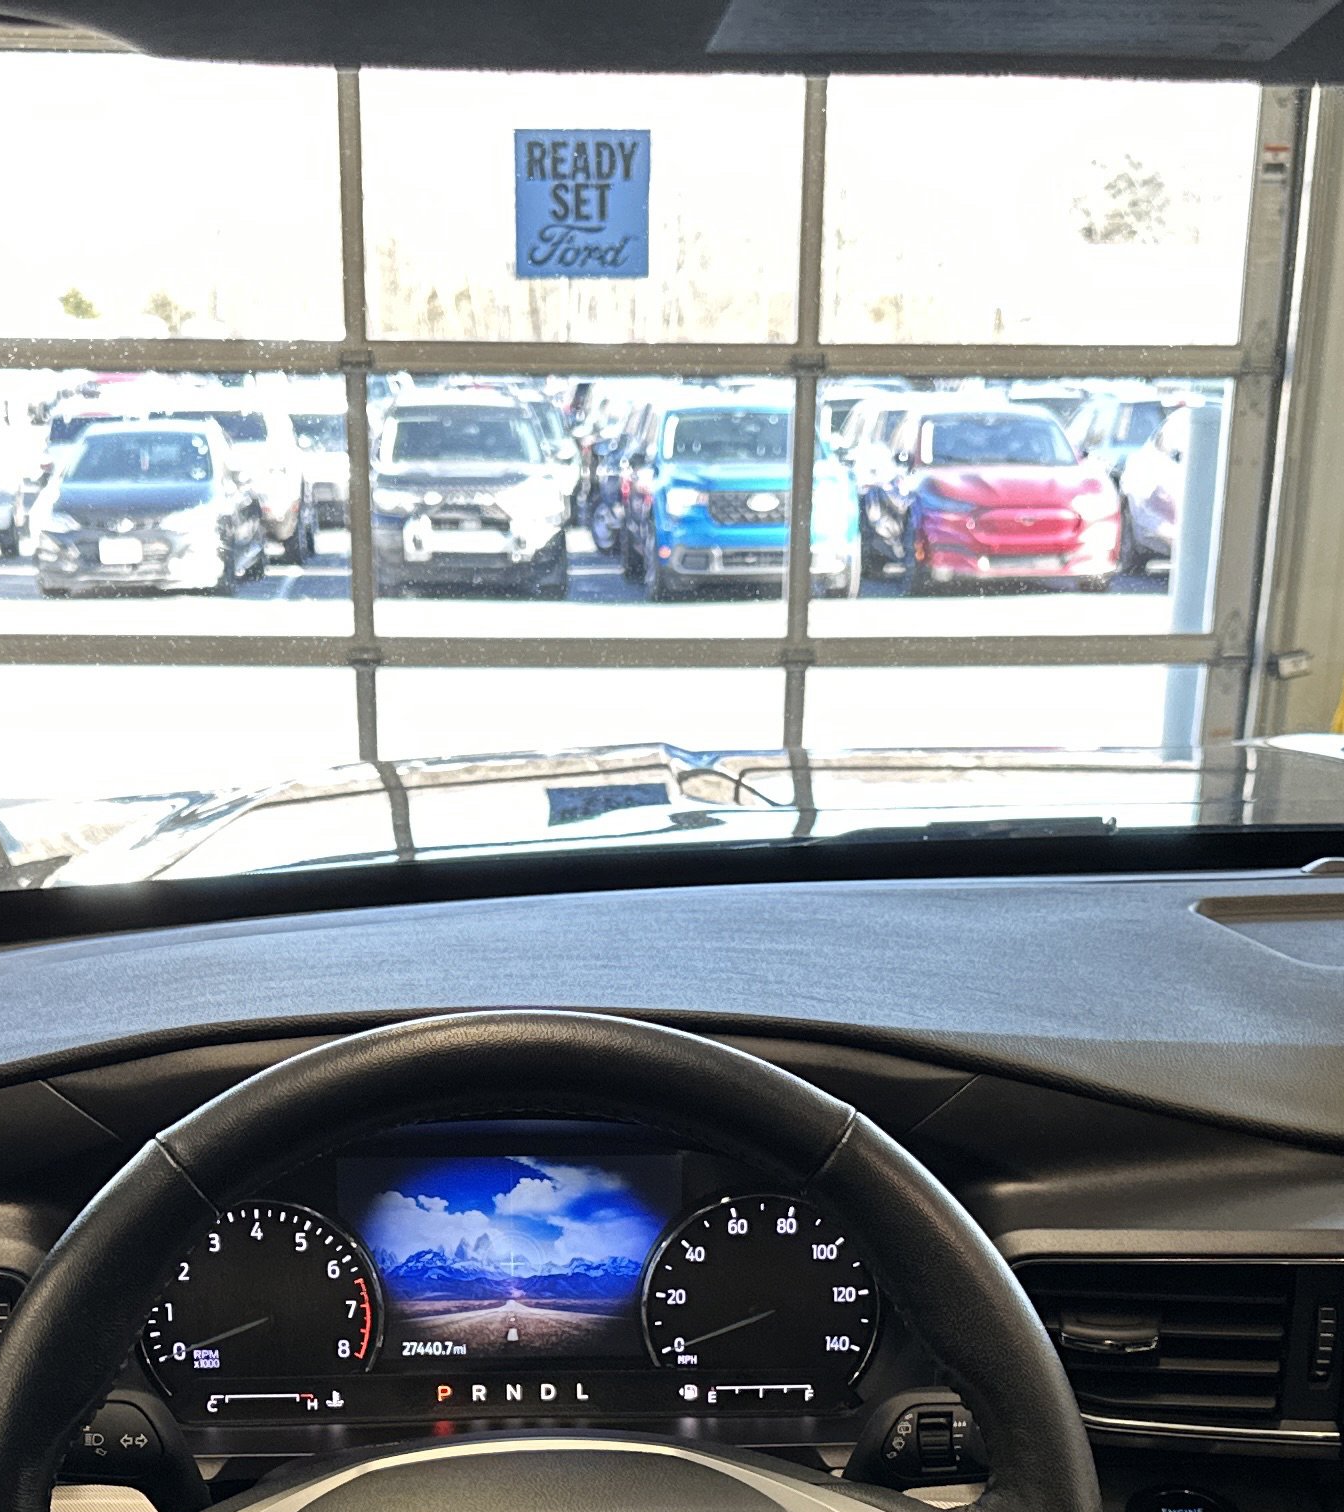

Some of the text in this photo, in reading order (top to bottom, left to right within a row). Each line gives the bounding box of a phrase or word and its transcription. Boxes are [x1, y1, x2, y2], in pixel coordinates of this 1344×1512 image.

[526, 141, 640, 180] READY
[550, 183, 611, 221] SET
[528, 223, 632, 267] Ford
[250, 1221, 263, 1240] 4
[727, 1219, 748, 1234] 60
[776, 1218, 797, 1234] 80
[208, 1233, 221, 1252] 3
[294, 1233, 307, 1251] 5
[685, 1246, 705, 1262] 40
[811, 1244, 837, 1260] 100
[177, 1262, 190, 1281] 2
[327, 1260, 340, 1279] 6
[666, 1289, 687, 1304] 20
[832, 1287, 856, 1302] 120
[164, 1303, 173, 1321] 1
[345, 1300, 357, 1319] 7
[172, 1342, 186, 1360] 0
[337, 1339, 350, 1358] 8
[674, 1338, 685, 1352] 0
[825, 1336, 850, 1351] 140
[193, 1350, 219, 1359] RPM
[677, 1355, 698, 1365] MPH
[193, 1360, 220, 1369] x1000
[437, 1383, 589, 1401] P R N D L
[707, 1391, 717, 1404] E
[805, 1389, 814, 1402] F
[206, 1400, 218, 1413] C
[307, 1399, 318, 1411] H
